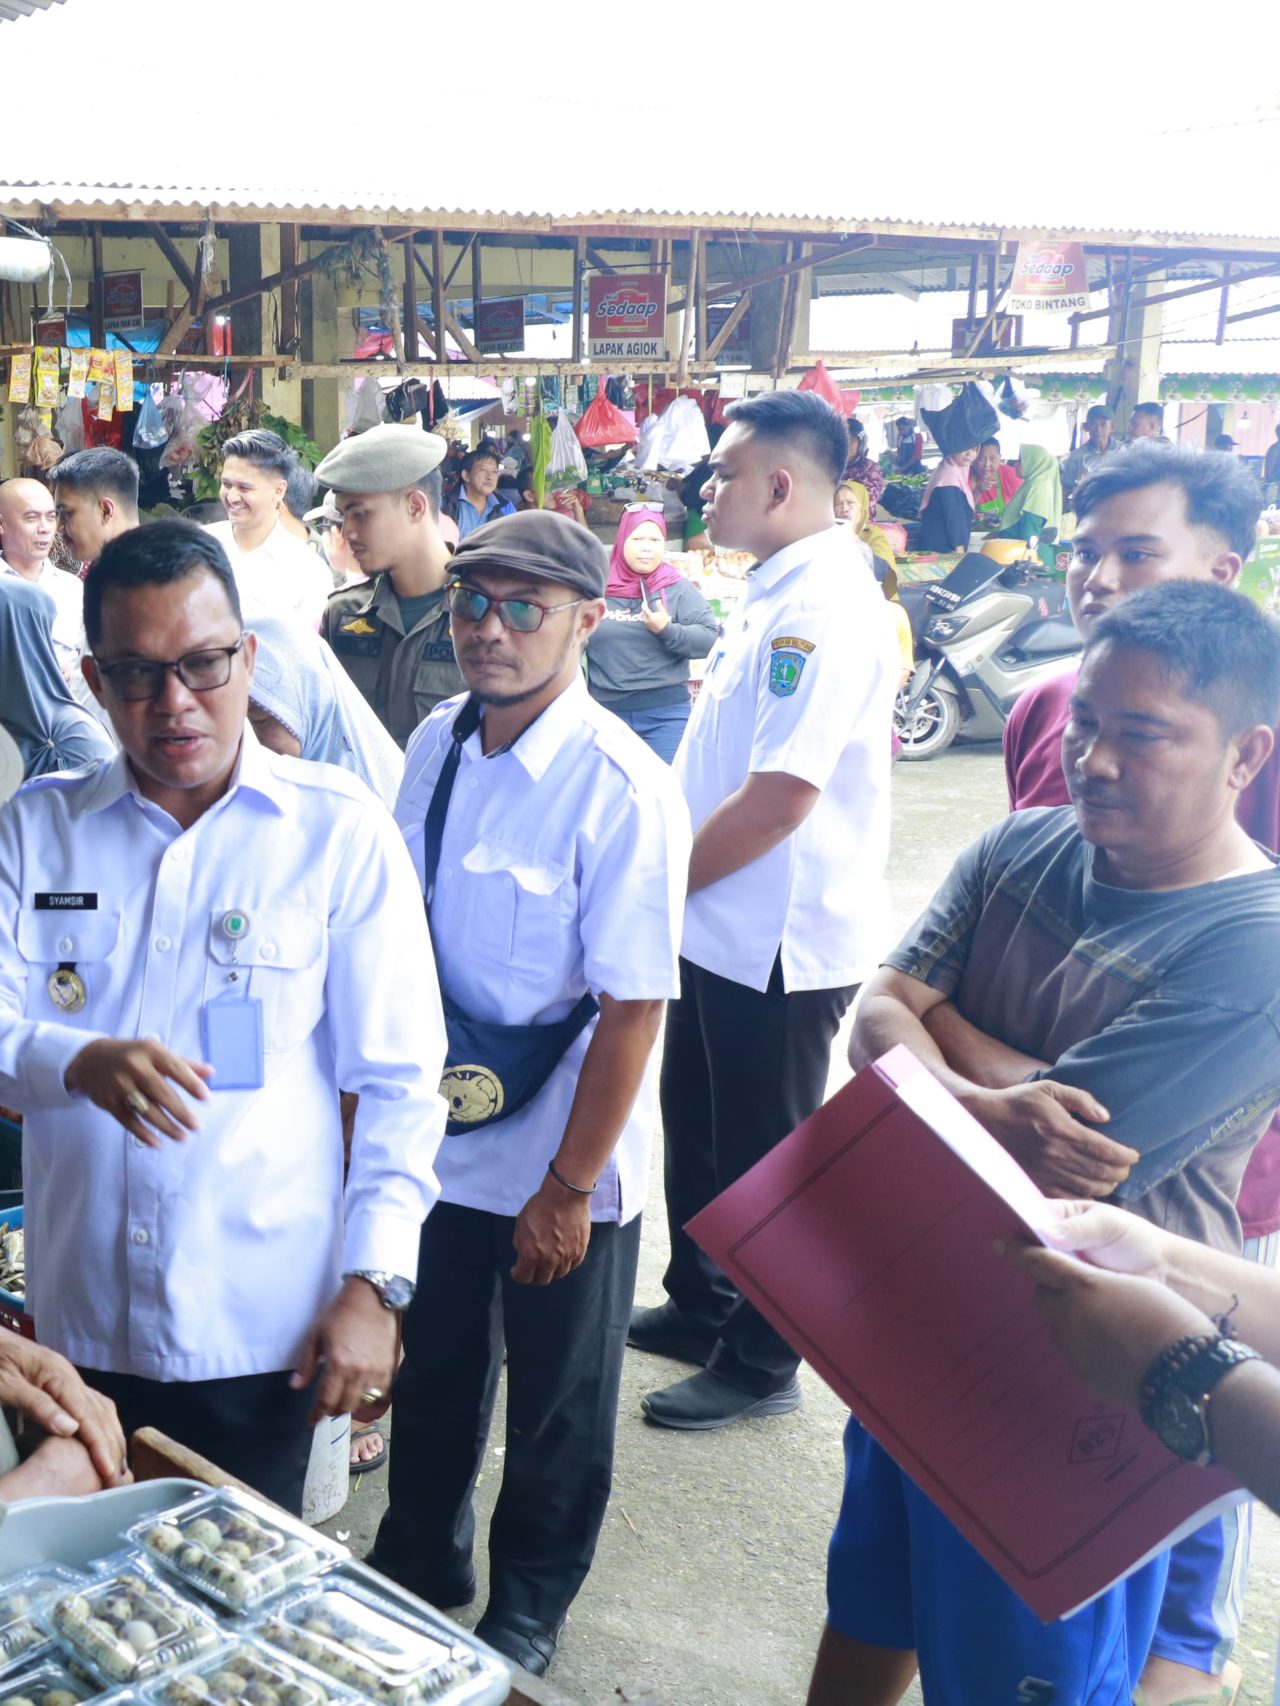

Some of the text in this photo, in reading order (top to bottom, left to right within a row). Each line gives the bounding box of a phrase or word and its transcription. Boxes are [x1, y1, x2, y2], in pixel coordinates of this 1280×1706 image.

[1021, 261, 1074, 277] Sedaap
[597, 300, 657, 318] Sedaap
[1011, 297, 1086, 310] TOKO BINTANG
[593, 342, 658, 356] LAPAK AGIOK
[49, 896, 84, 906] SYAMSIR
